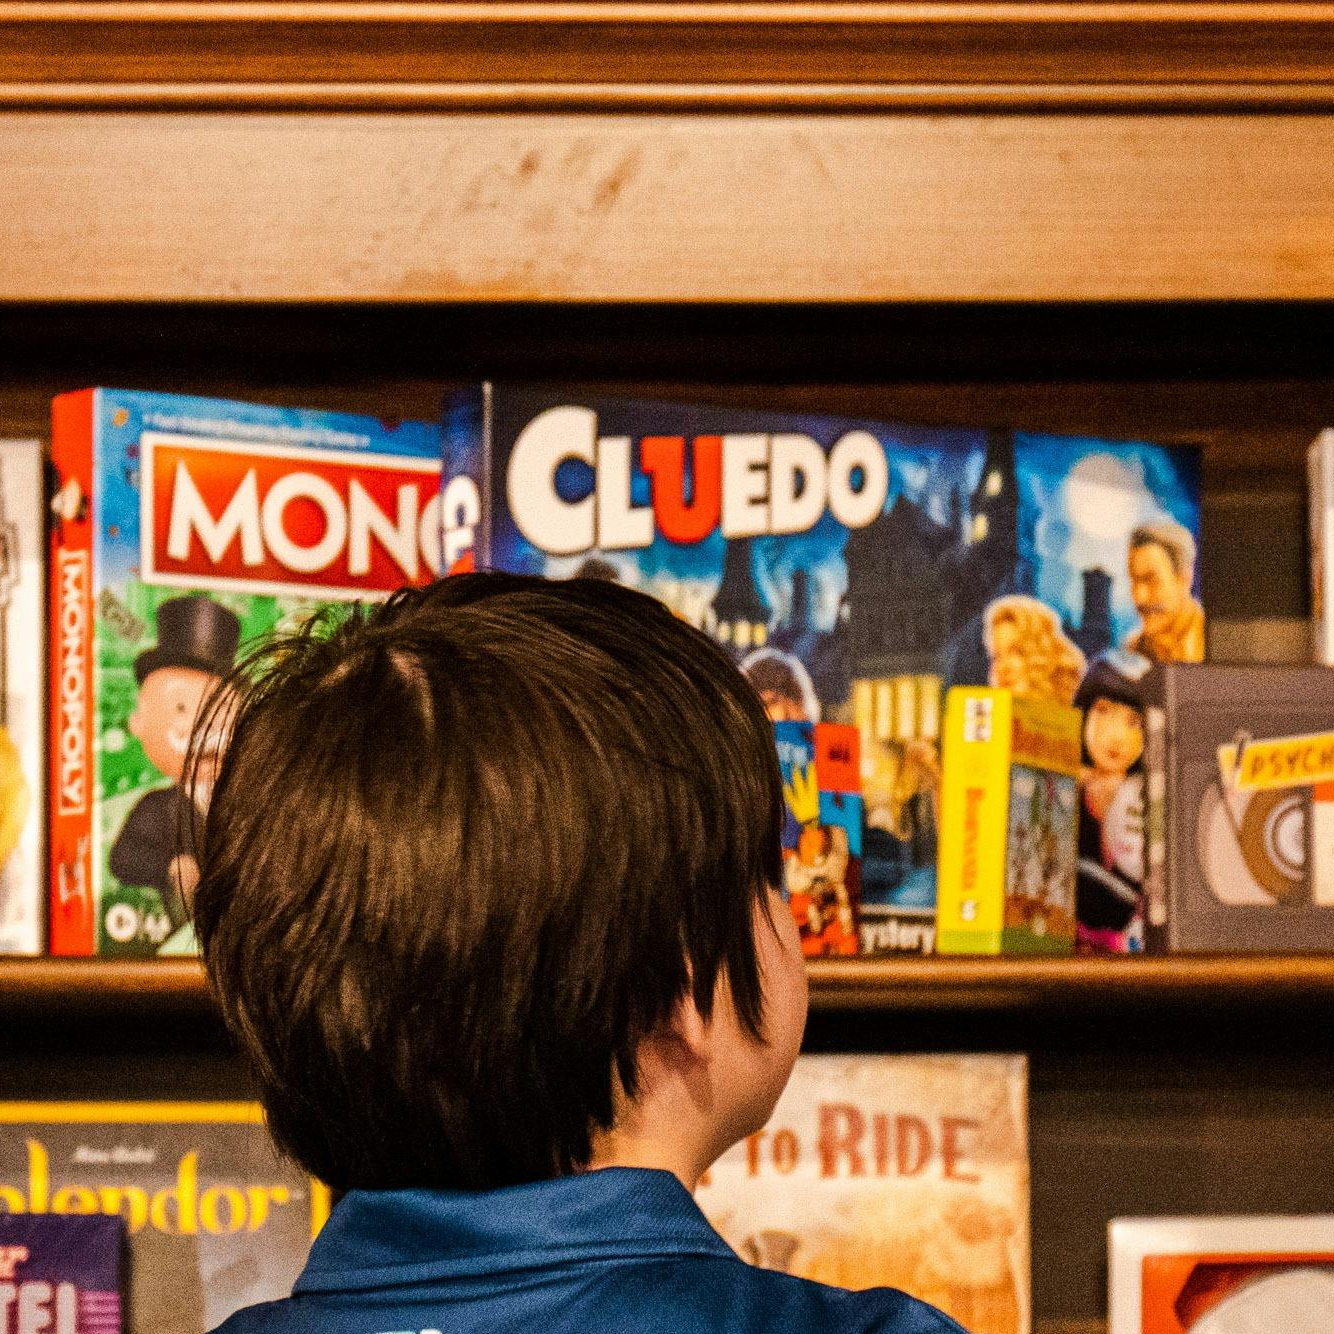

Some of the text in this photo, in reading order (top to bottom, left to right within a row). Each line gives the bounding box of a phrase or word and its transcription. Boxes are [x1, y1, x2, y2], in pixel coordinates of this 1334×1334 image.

[507, 405, 888, 555] CLUEDO
[61, 563, 86, 804] MONOPOLY
[860, 917, 936, 956] ystery
[818, 1102, 981, 1183] RIDE
